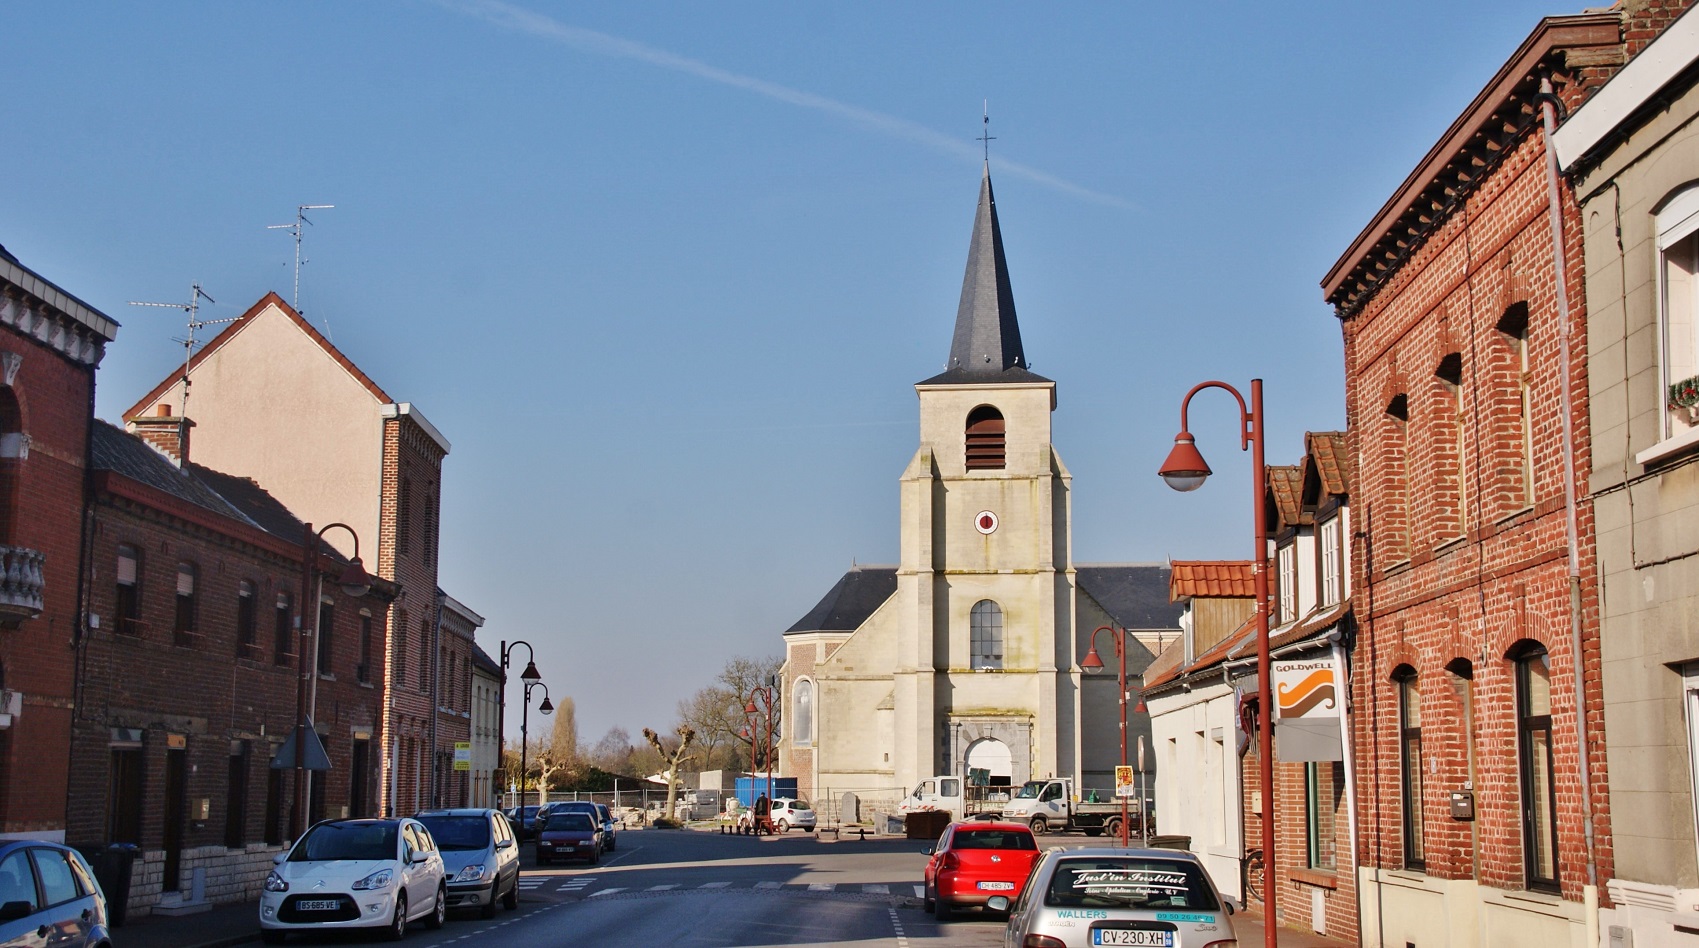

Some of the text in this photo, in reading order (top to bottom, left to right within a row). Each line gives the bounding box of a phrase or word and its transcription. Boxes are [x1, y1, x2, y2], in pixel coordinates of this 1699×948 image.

[1276, 662, 1333, 672] GOLDWELL
[1128, 872, 1187, 884] Institut
[1057, 910, 1108, 919] WALLERS
[1102, 930, 1164, 945] CV-230-XH
